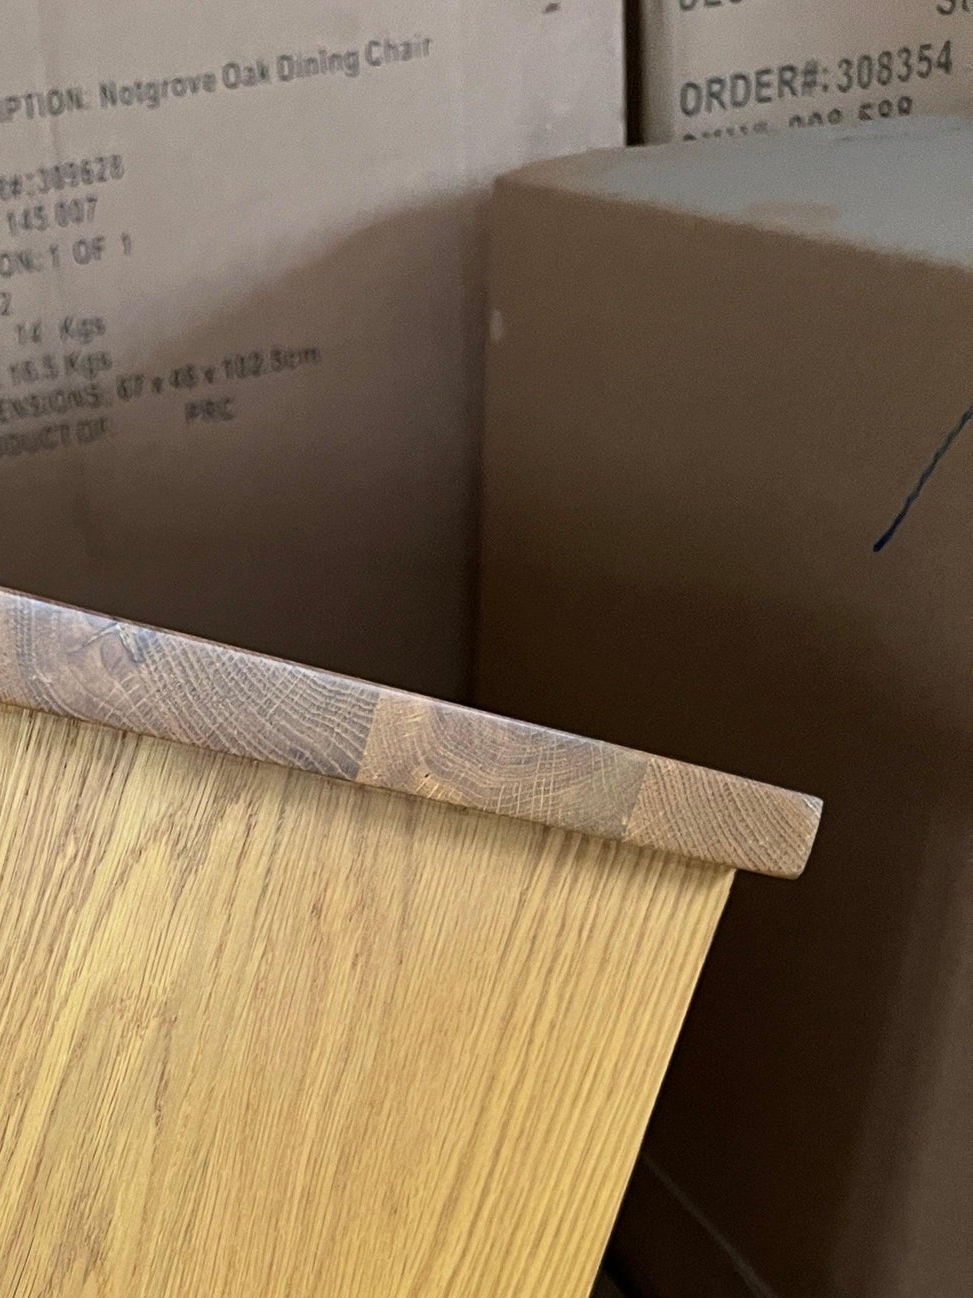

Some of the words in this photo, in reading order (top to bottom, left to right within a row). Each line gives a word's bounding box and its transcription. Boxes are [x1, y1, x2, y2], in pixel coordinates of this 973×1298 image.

[98, 72, 217, 109] Notgrove
[221, 59, 271, 90] Oak
[277, 47, 360, 78] Dining
[365, 36, 432, 67] Chair
[679, 40, 952, 118] ORDER#:308354
[49, 243, 61, 268] 1
[73, 235, 106, 265] OF
[121, 232, 132, 256] 1
[59, 315, 107, 345] Kgs
[63, 350, 113, 381] Kgs
